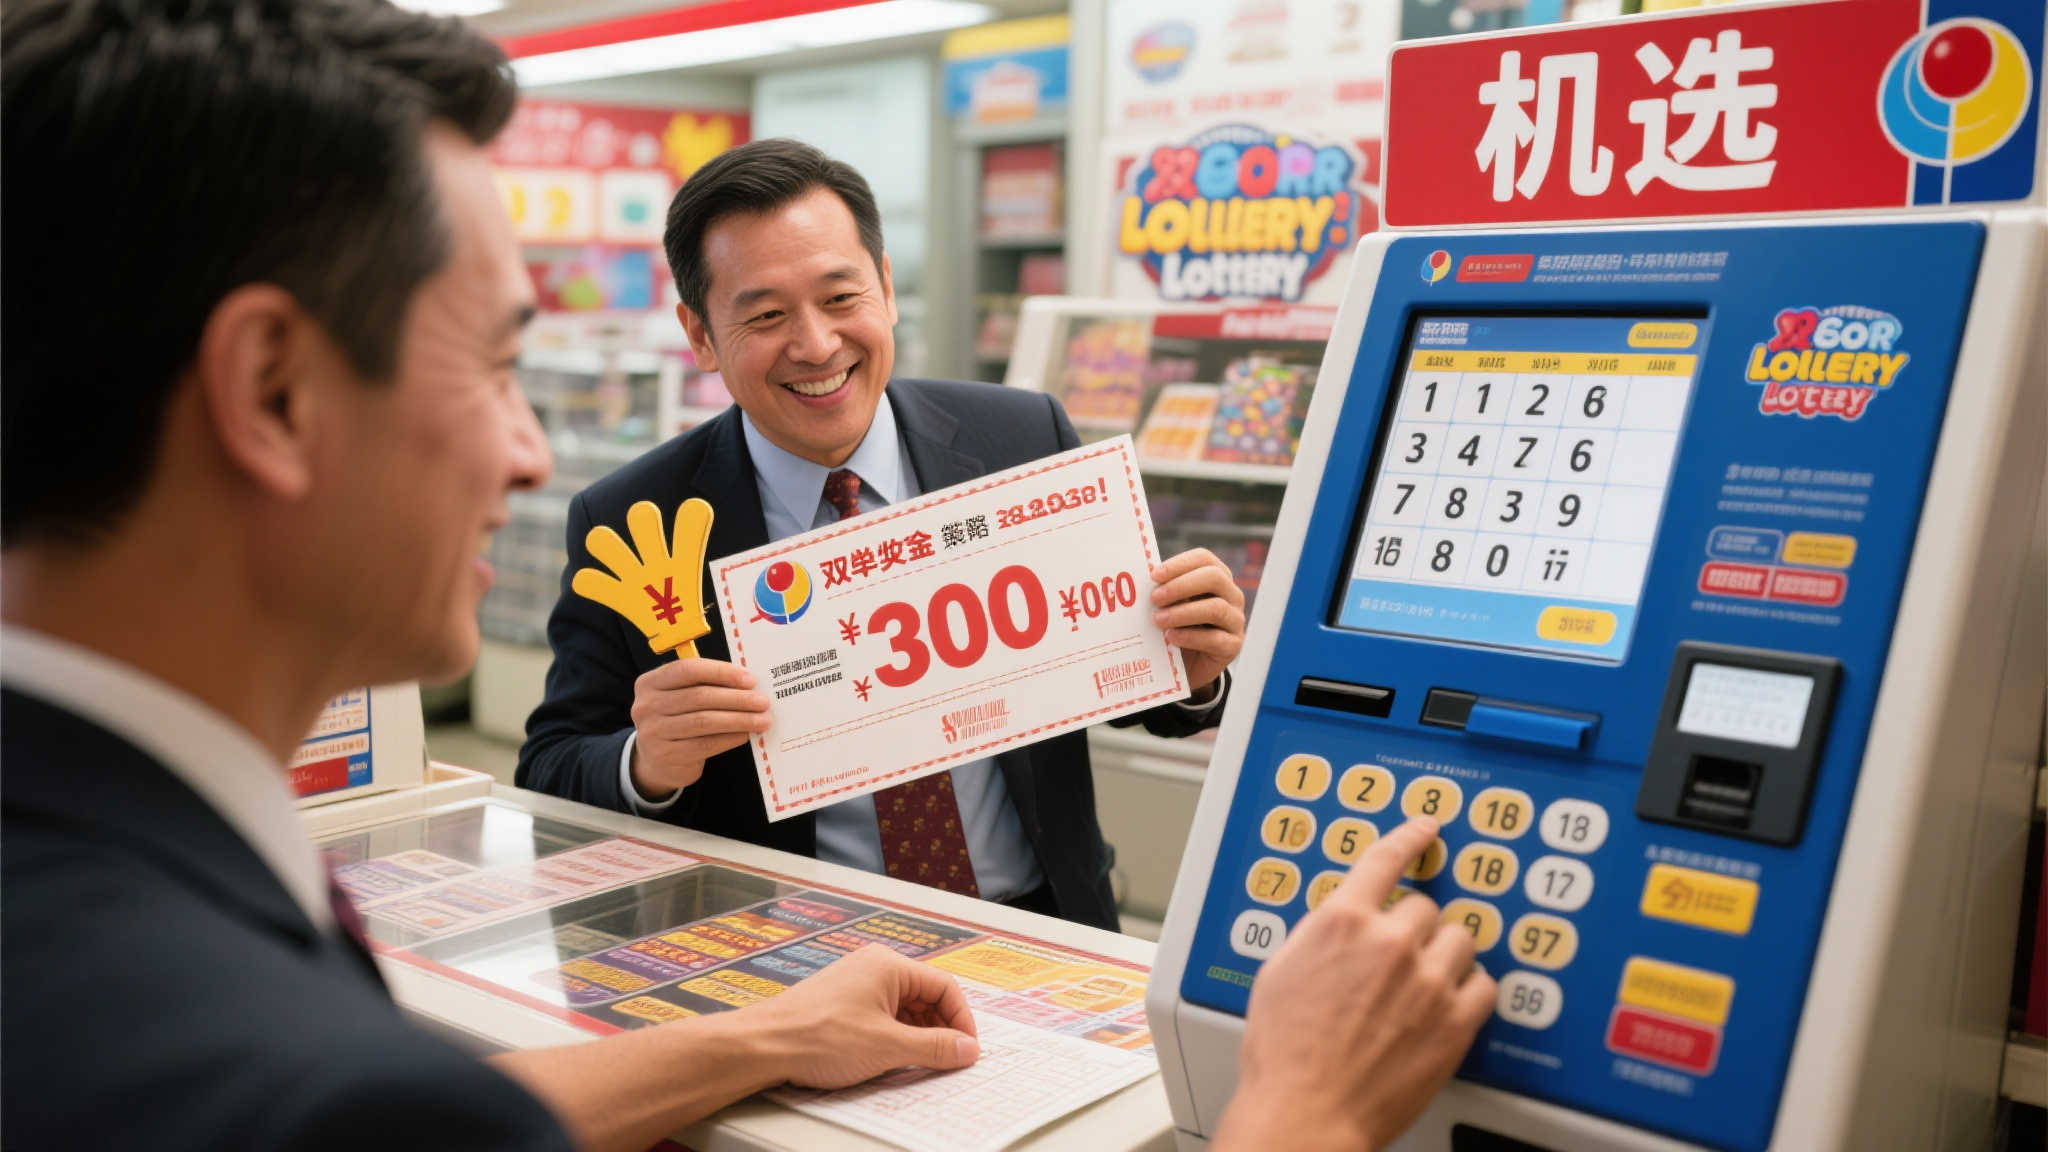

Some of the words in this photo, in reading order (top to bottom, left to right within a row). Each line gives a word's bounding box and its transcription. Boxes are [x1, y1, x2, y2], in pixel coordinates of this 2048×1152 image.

[1474, 29, 1779, 203] 机选
[1424, 381, 1438, 412] 1
[1477, 383, 1491, 414] 1
[1525, 384, 1549, 416] 2
[1405, 433, 1428, 464] 3
[1457, 435, 1481, 466] 4
[1513, 437, 1538, 468] 7
[1570, 439, 1594, 472] 6
[1393, 484, 1416, 515] 7
[1444, 487, 1468, 519] 8
[1499, 490, 1523, 523] 3
[1557, 494, 1581, 527] 9
[1430, 540, 1454, 572] 8
[1485, 544, 1509, 577] 0
[643, 576, 684, 626] ¥
[867, 564, 1049, 688] 300
[1297, 765, 1308, 790] 1
[1357, 776, 1376, 803] 2
[1471, 854, 1505, 887] 18
[1544, 869, 1576, 899] 17
[1244, 922, 1272, 949] 00
